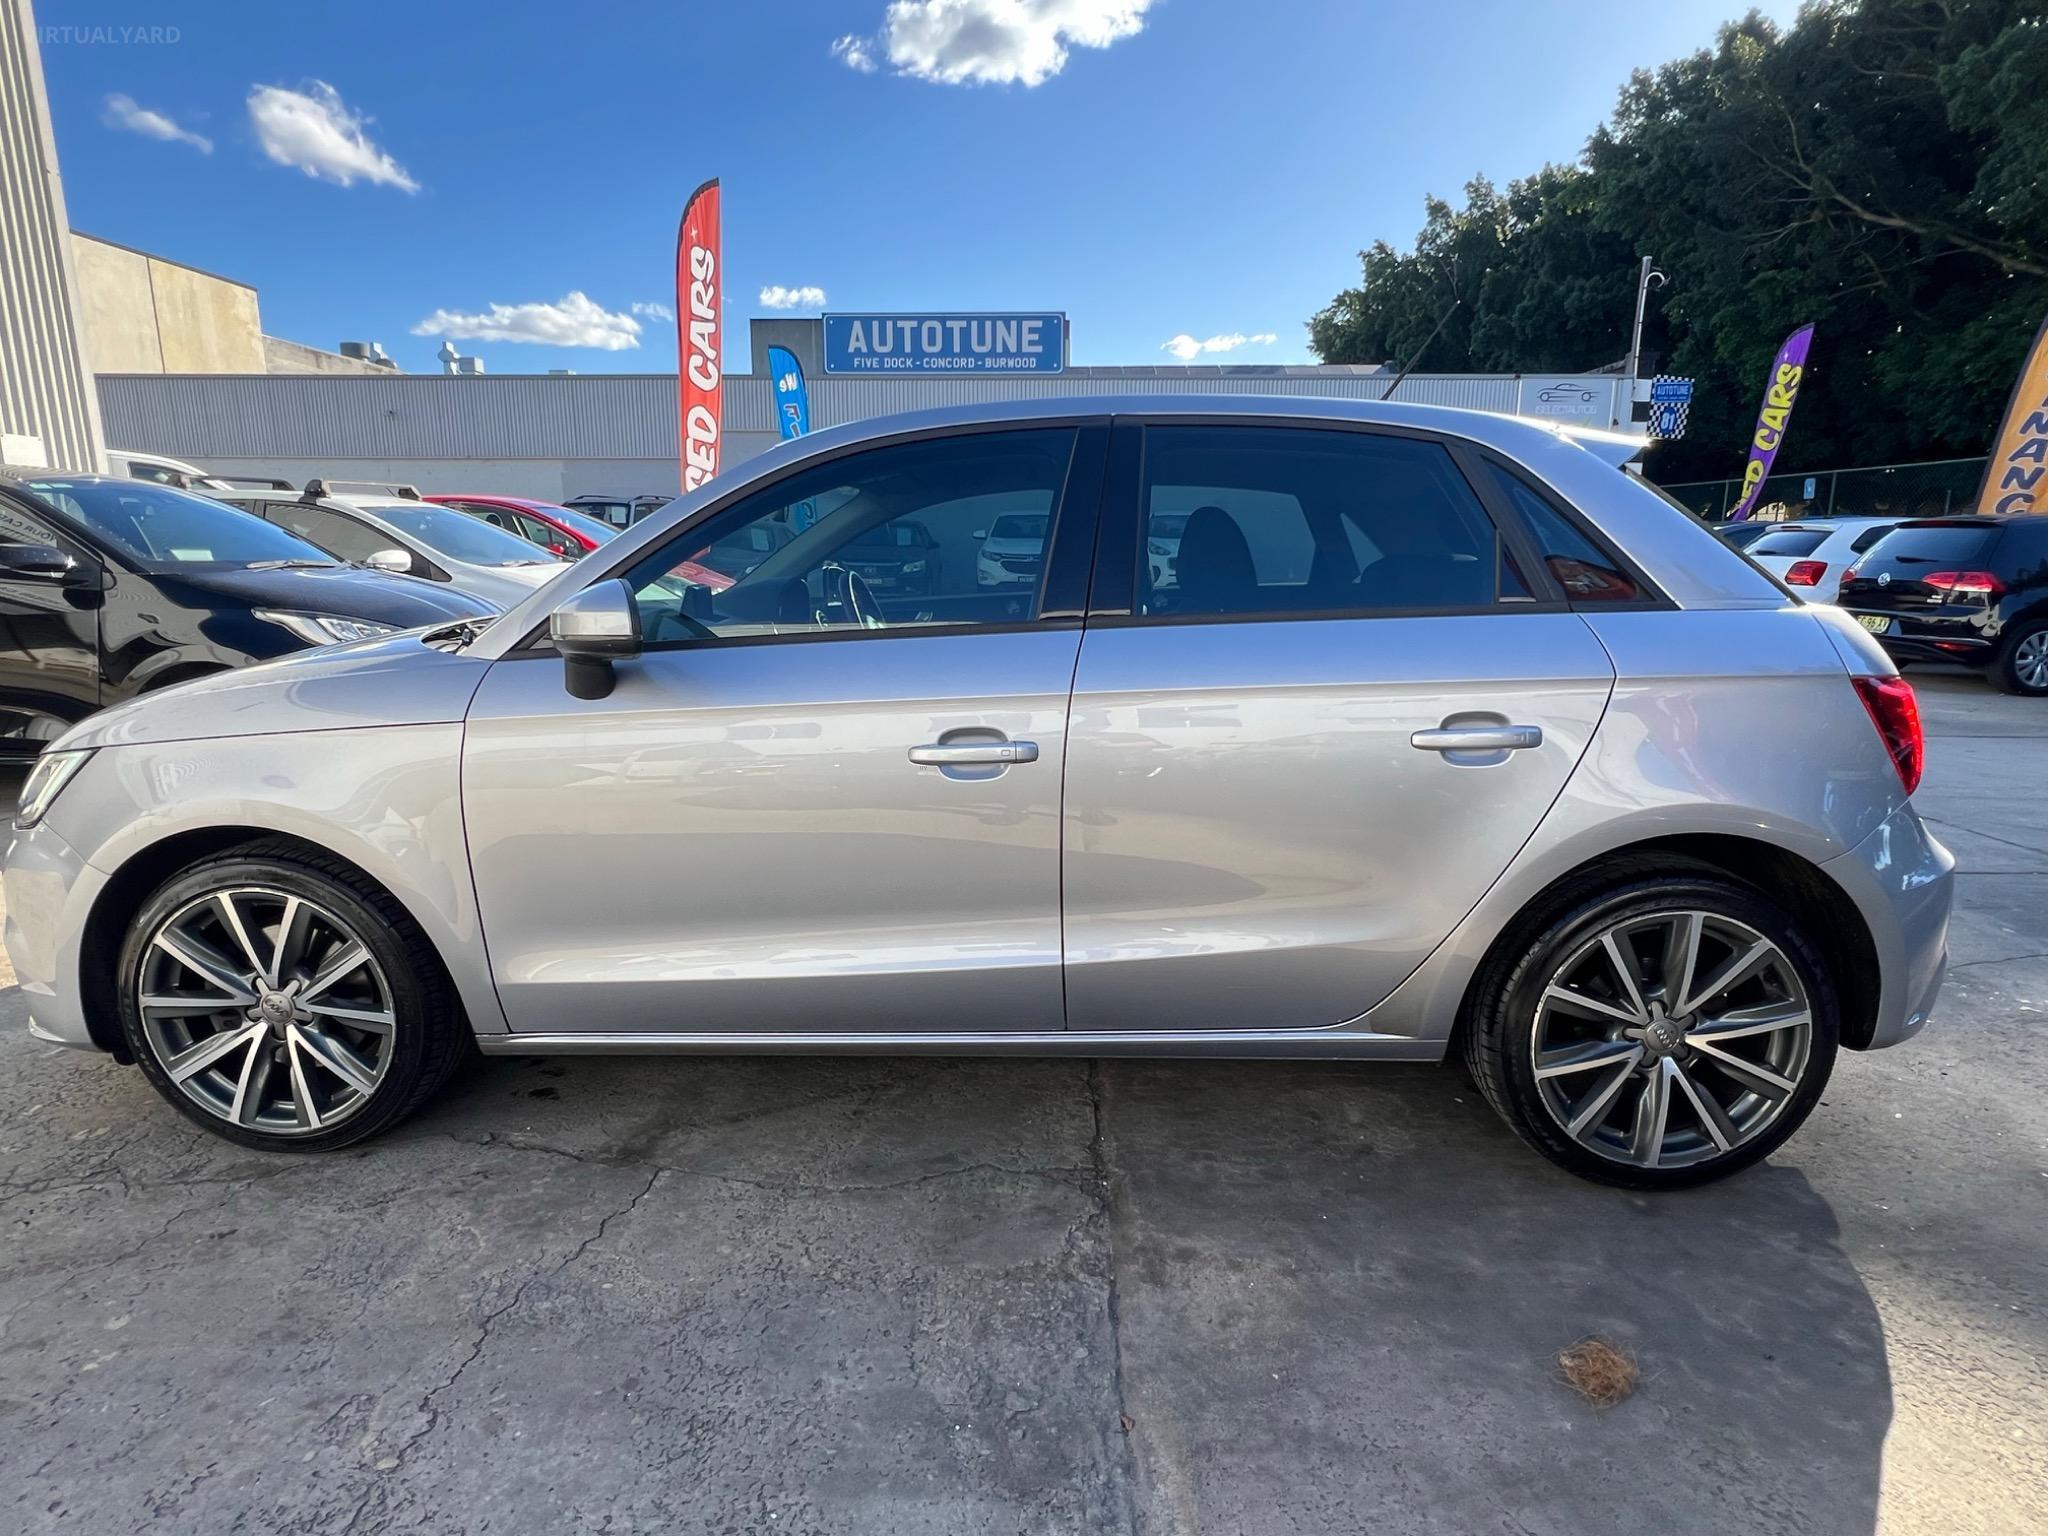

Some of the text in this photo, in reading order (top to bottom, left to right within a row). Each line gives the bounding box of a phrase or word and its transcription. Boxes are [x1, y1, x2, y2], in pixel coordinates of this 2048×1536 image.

[688, 245, 719, 392] CARS
[848, 320, 1043, 353] AUTOTUNE
[854, 358, 880, 368] FIVE
[884, 358, 913, 368] DOCK
[923, 358, 975, 368] CONCORD
[985, 358, 1036, 368] BURWOOD
[1754, 363, 1802, 451] CARS
